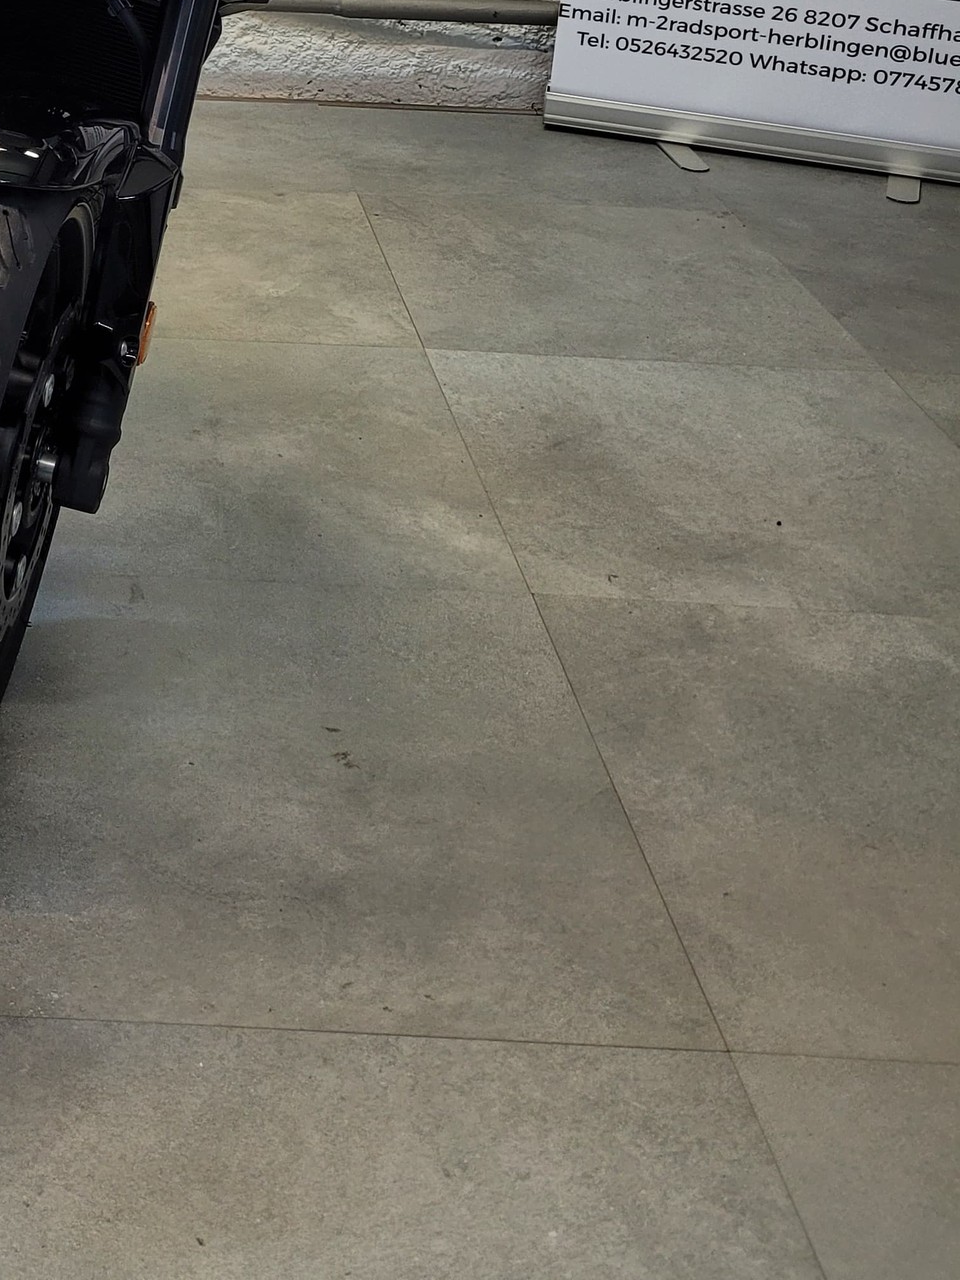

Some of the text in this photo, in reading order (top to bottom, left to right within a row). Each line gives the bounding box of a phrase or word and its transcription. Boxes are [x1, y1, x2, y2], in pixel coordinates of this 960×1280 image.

[559, 3, 621, 26] Email:
[771, 5, 797, 22] 26
[803, 10, 860, 29] 8207
[577, 31, 610, 50] Tel:
[615, 36, 742, 66] 0526432520
[750, 53, 866, 84] Whatsapp:
